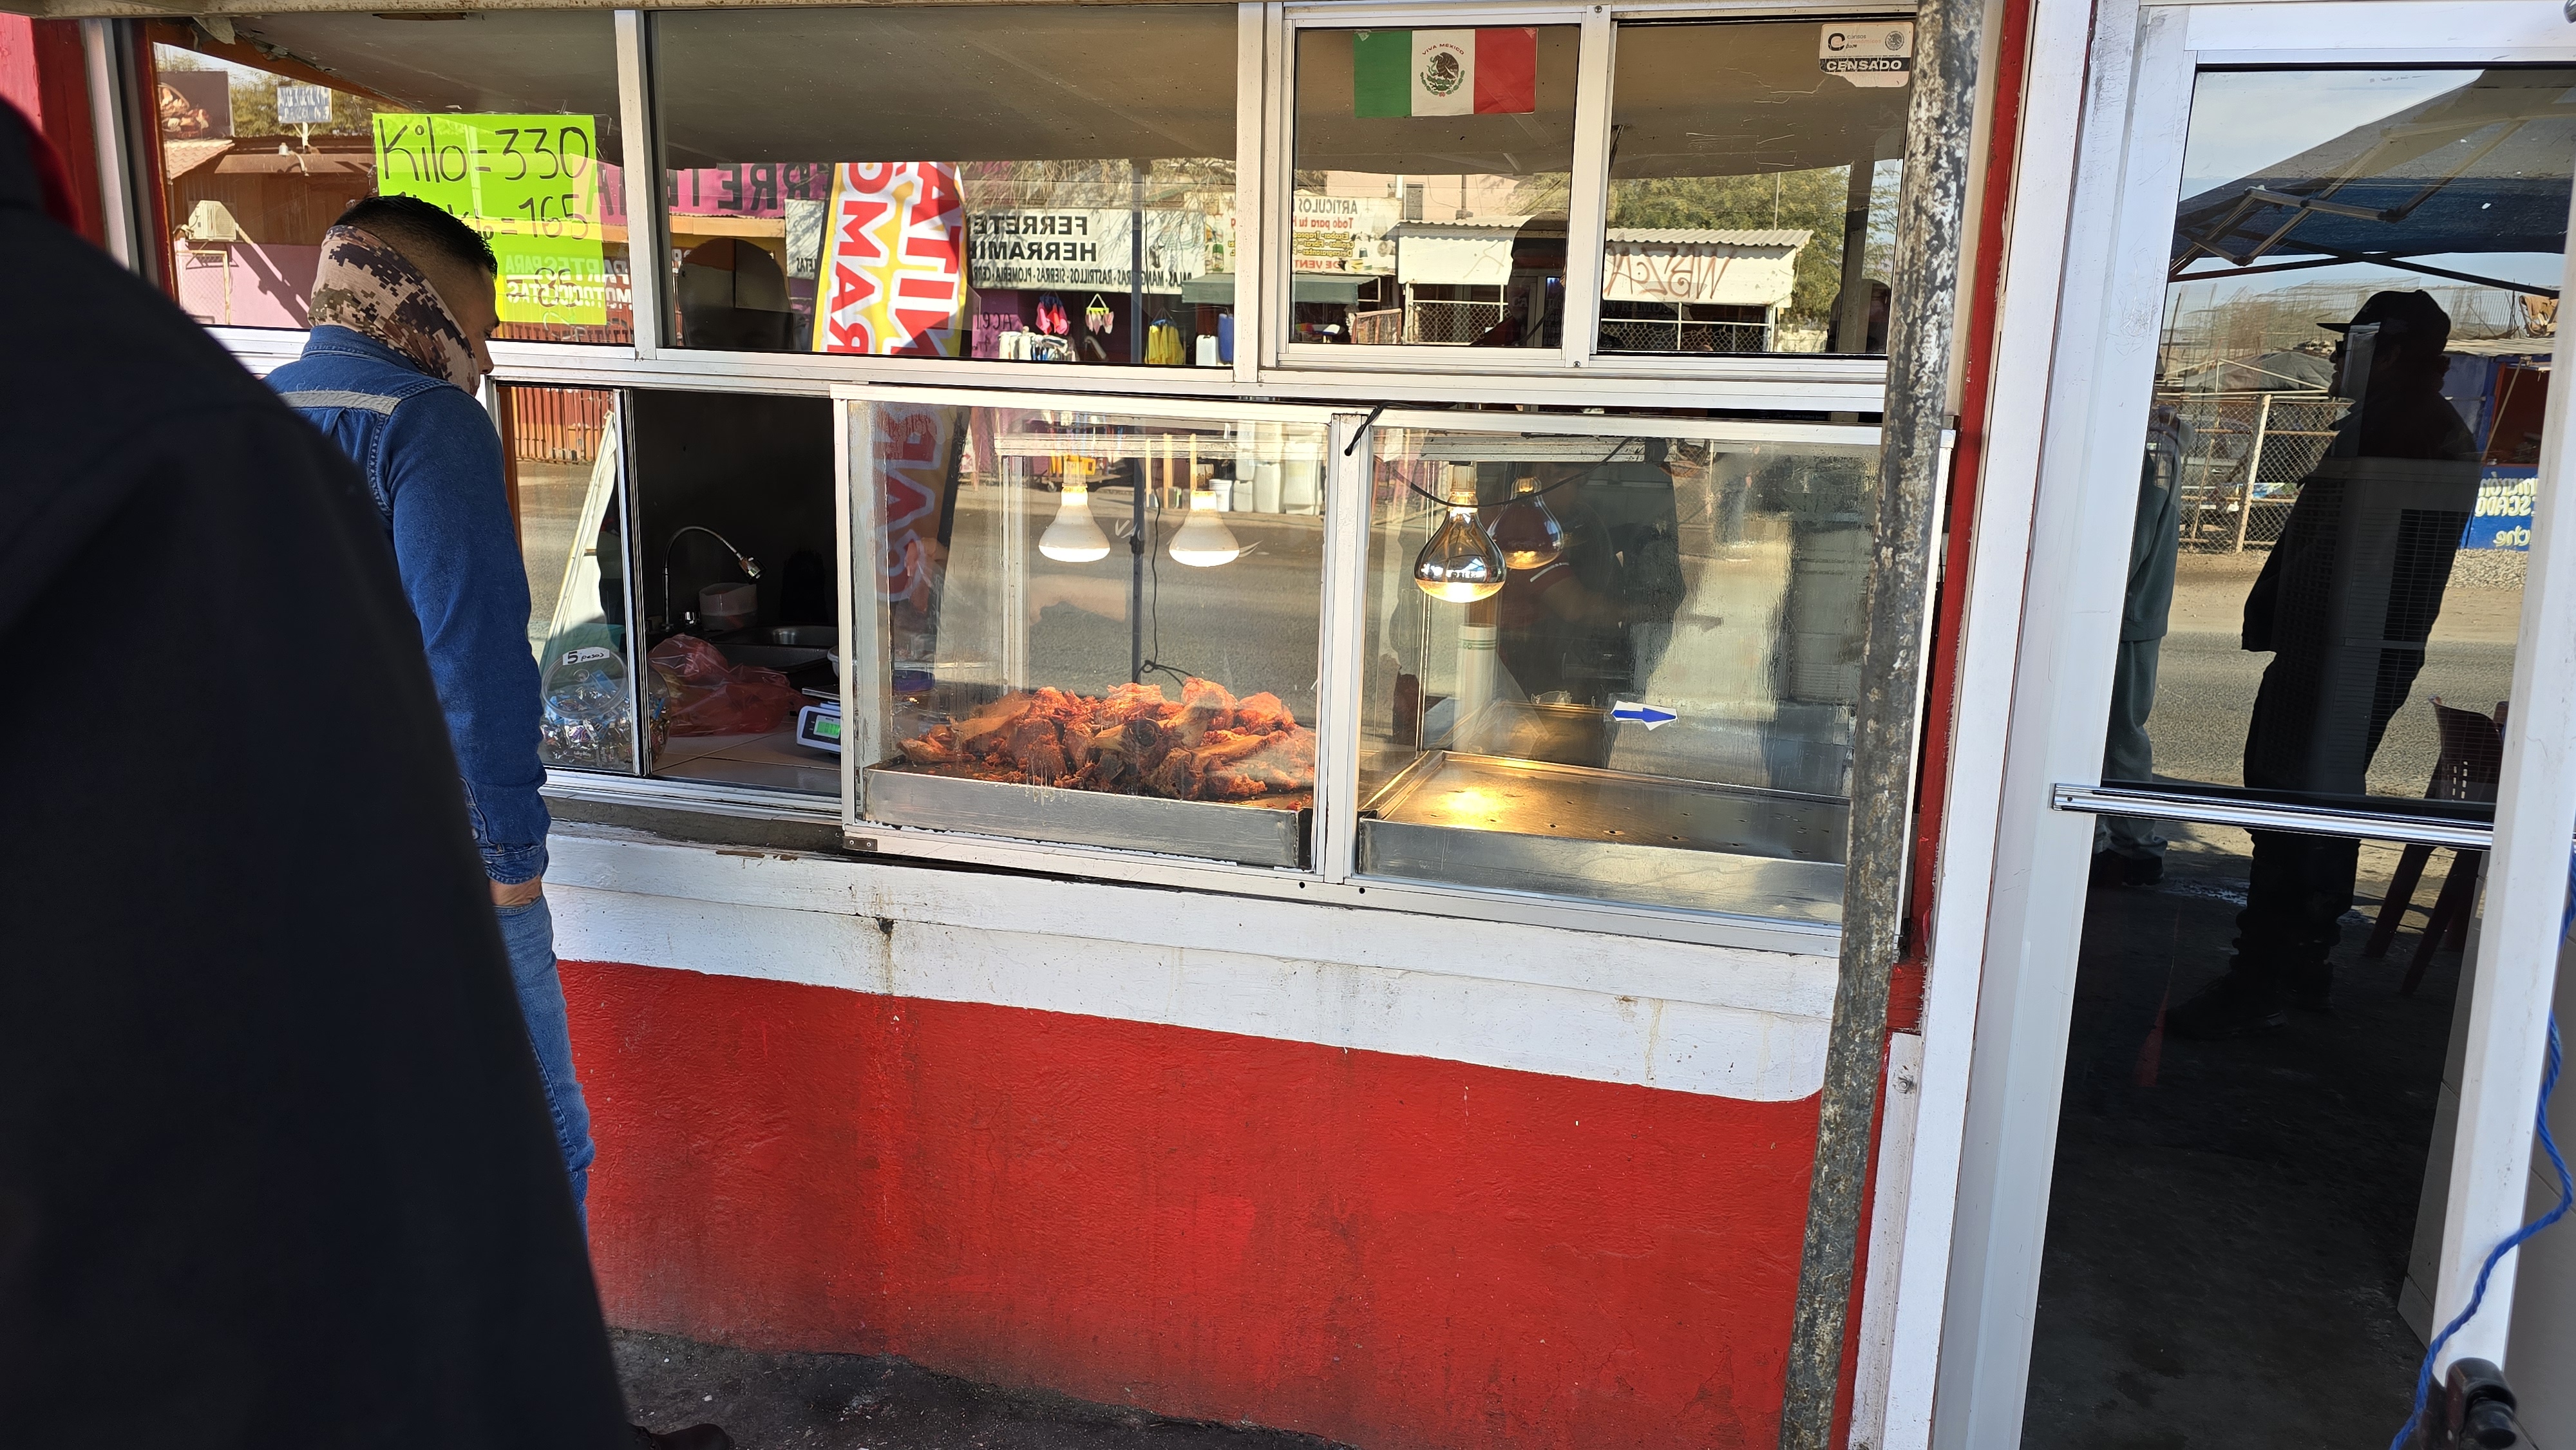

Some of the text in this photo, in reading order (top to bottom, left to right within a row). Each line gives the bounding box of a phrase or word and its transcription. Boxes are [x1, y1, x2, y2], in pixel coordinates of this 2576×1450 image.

[1422, 44, 1437, 55] VIVA
[1826, 60, 1902, 71] CENSADO
[567, 651, 604, 664] 5 pesos
